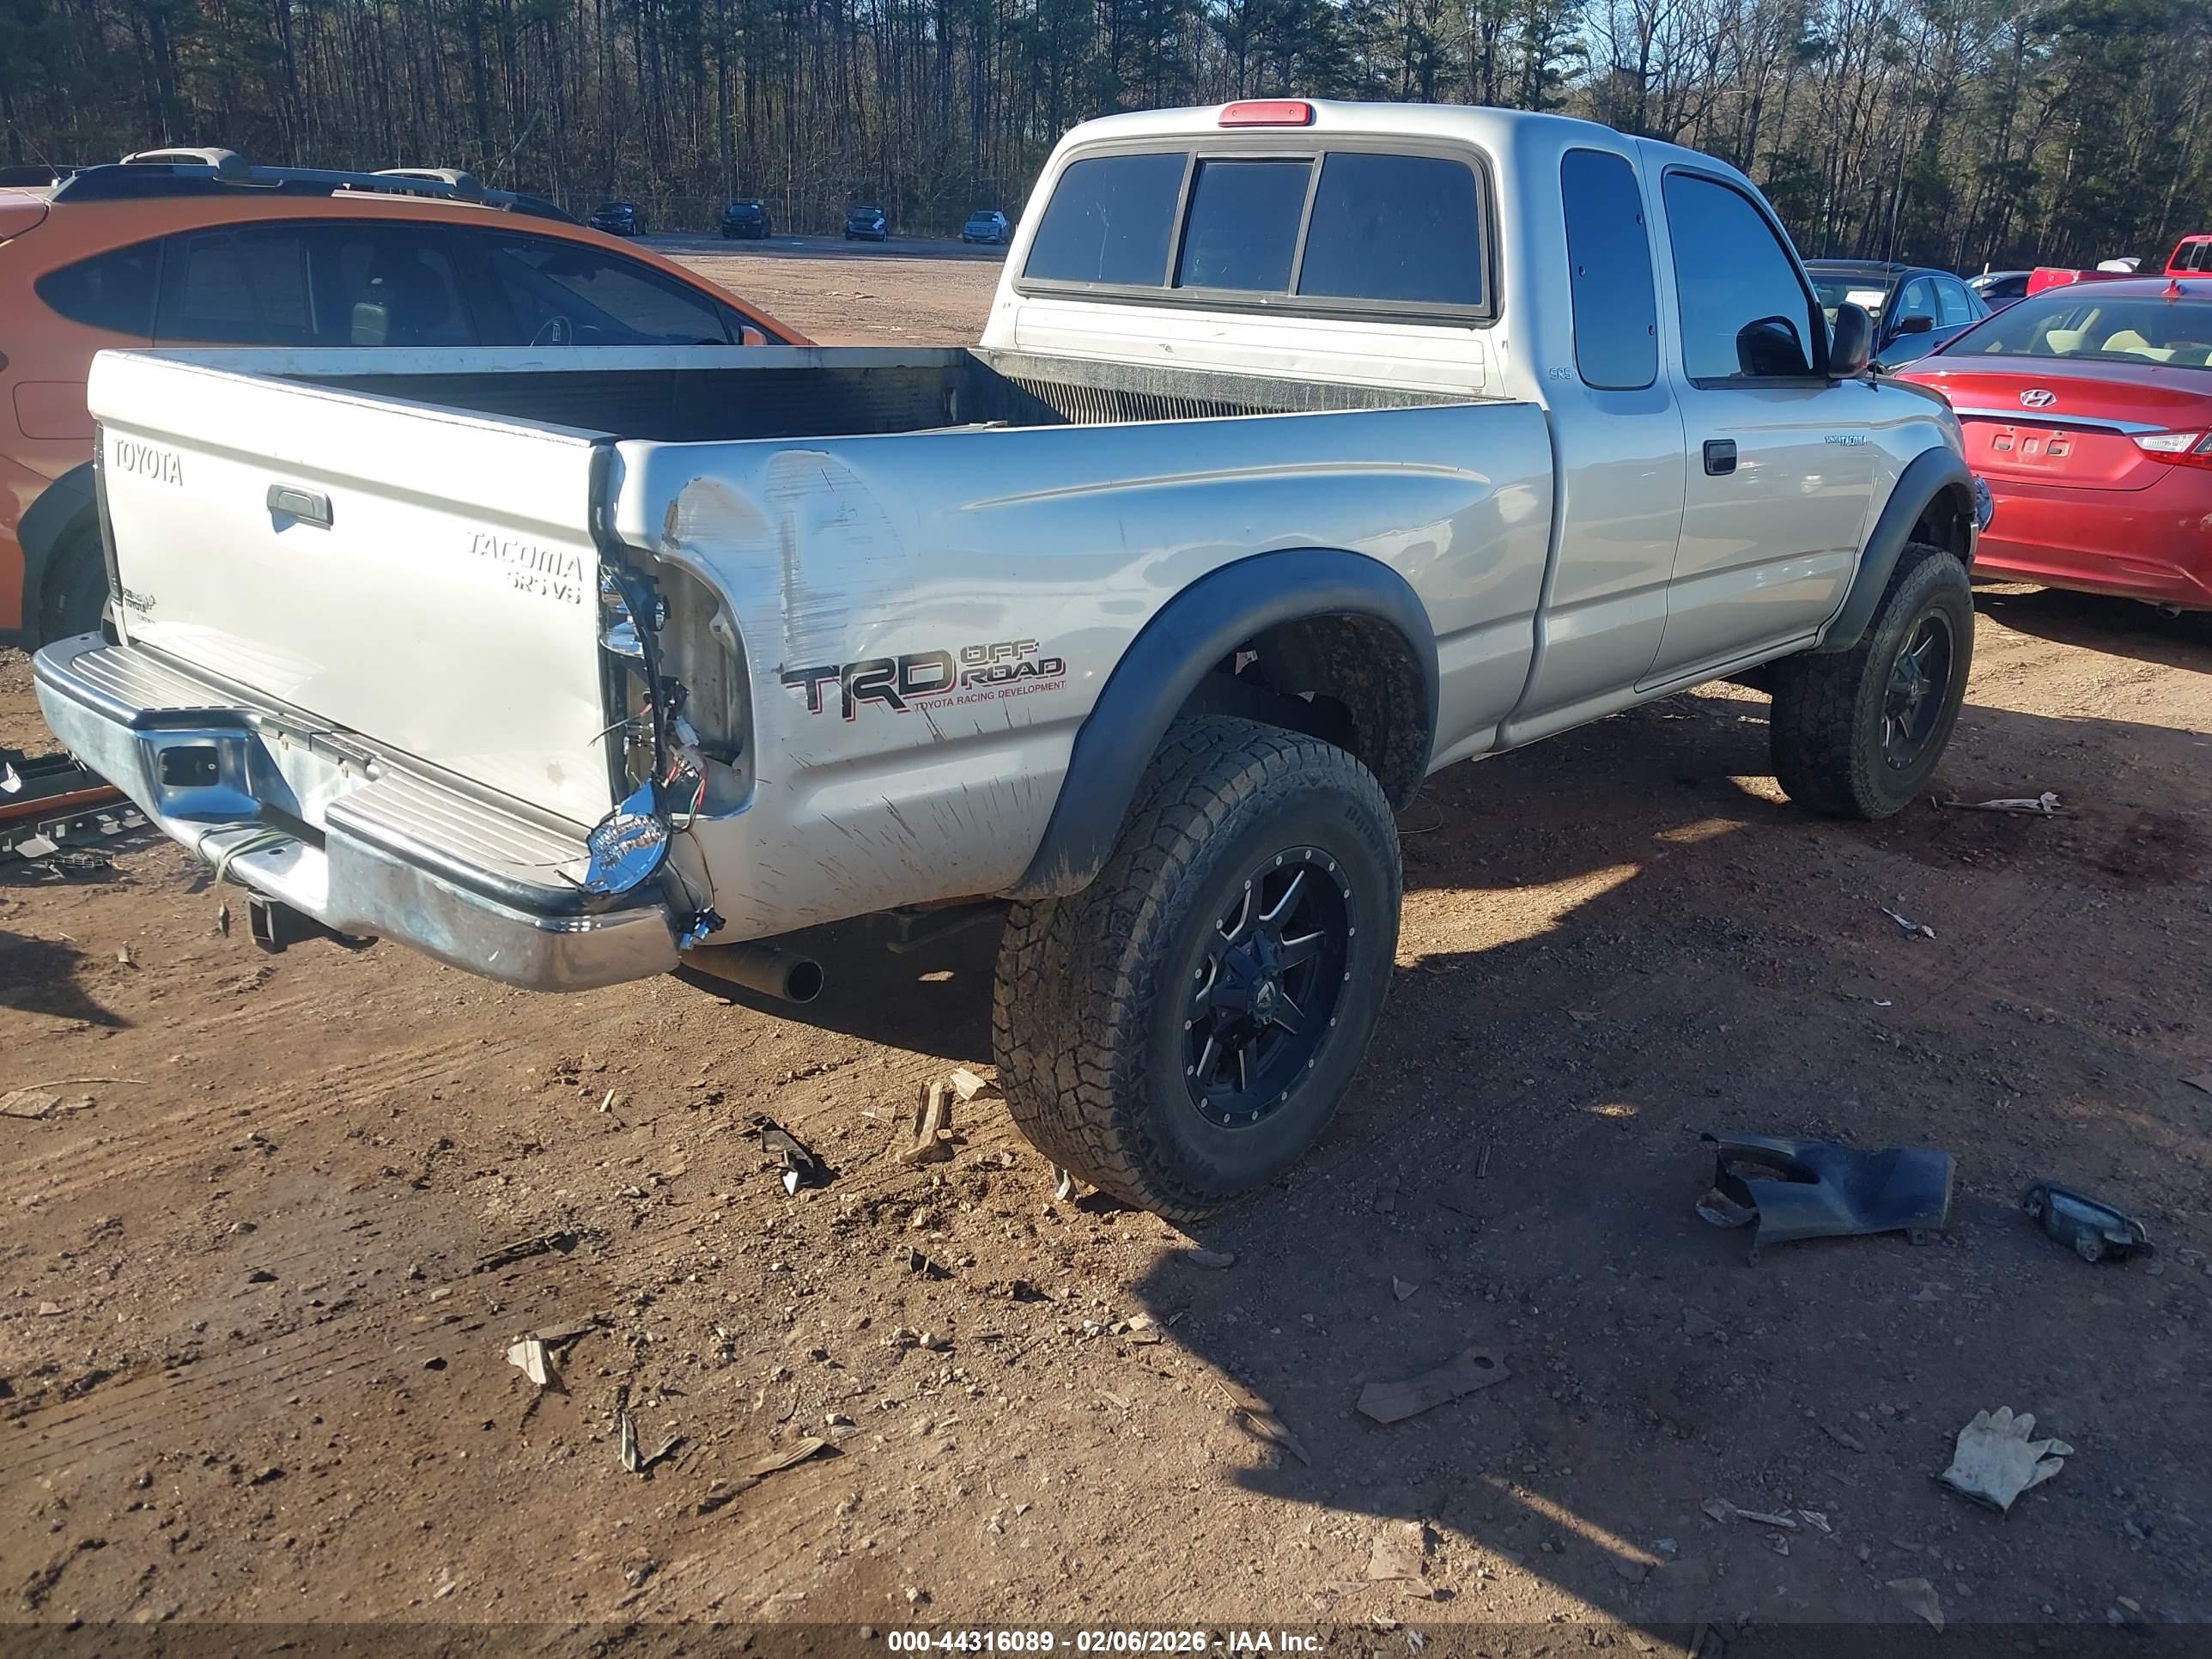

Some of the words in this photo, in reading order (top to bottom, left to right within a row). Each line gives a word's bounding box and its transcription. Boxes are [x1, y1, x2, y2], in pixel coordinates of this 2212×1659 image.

[113, 439, 185, 488] TOYOTA
[466, 531, 583, 582] TACOMA
[553, 580, 581, 605] V6
[959, 638, 1040, 666] OFF
[780, 649, 957, 722] TRD
[959, 656, 1066, 690] ROAD
[914, 698, 954, 712] TOYOTA
[957, 690, 995, 706] RACING
[998, 680, 1066, 698] DEVELOPMENT
